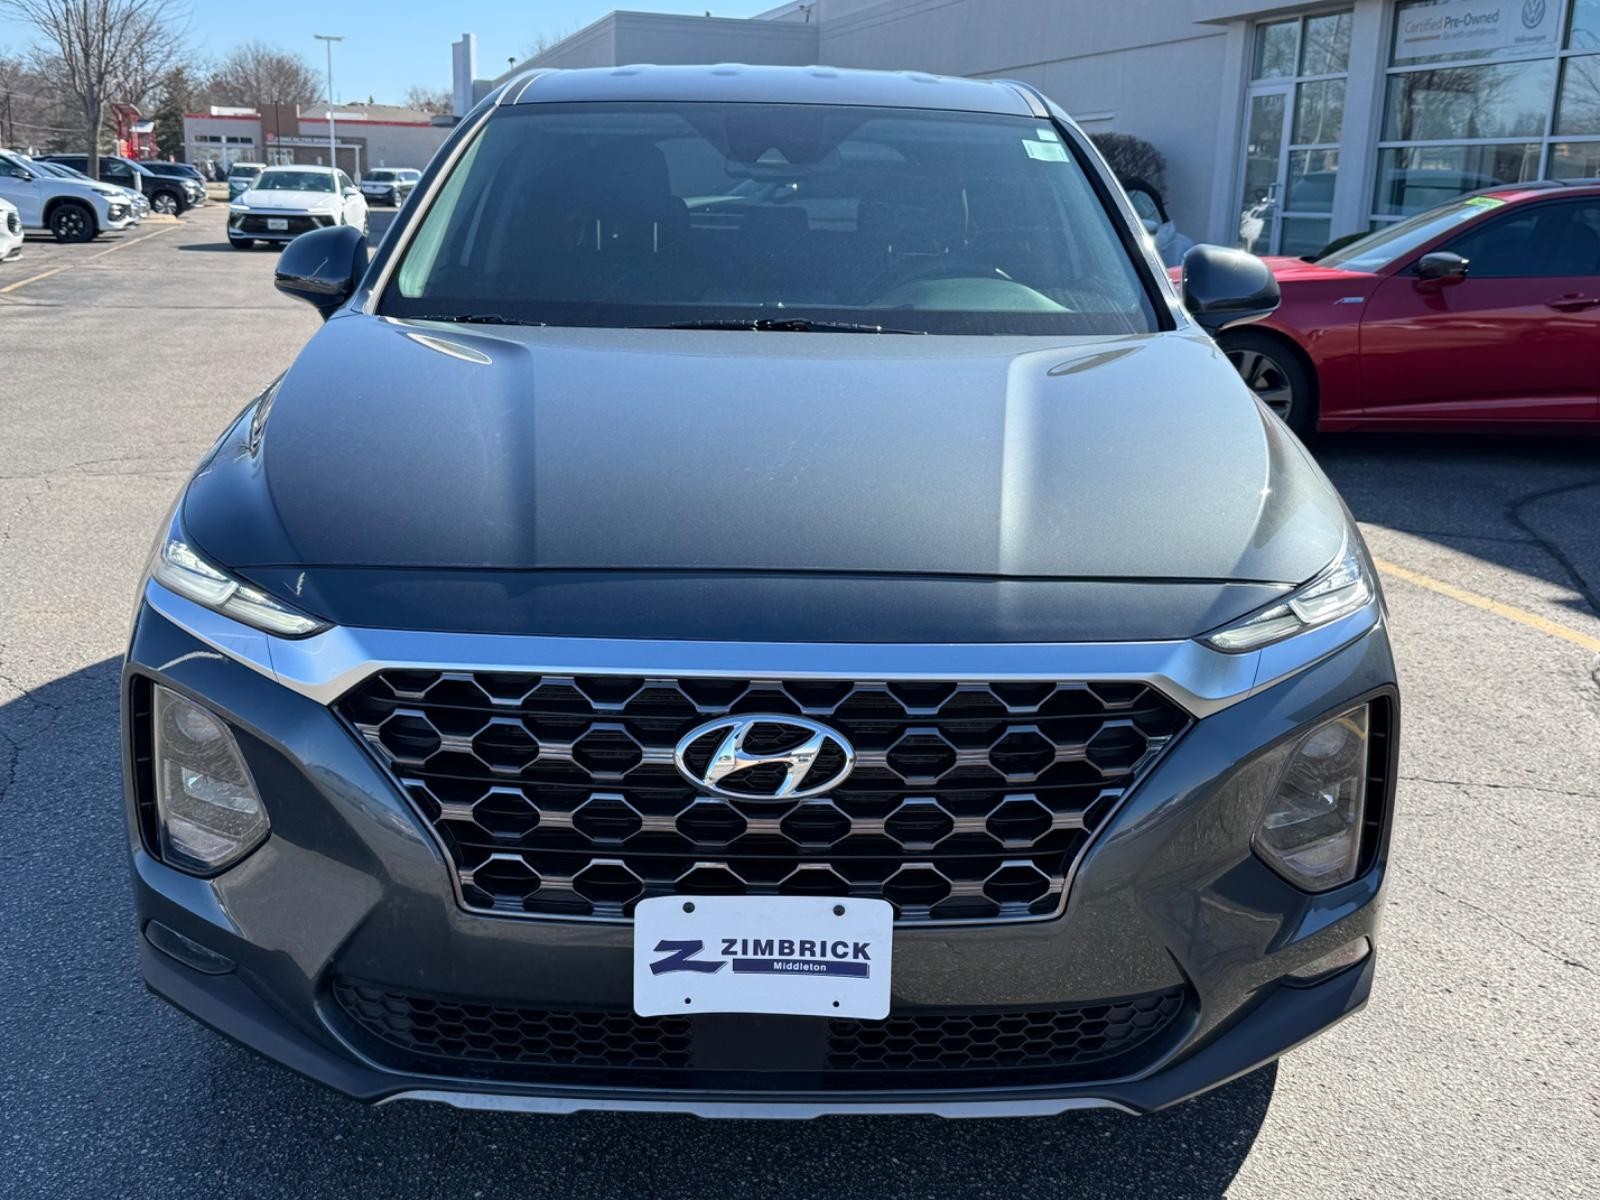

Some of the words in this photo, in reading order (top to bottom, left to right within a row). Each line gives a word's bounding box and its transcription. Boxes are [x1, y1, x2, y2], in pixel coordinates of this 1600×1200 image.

[1444, 9, 1499, 29] Pre-Owned
[721, 938, 871, 960] ZIMBRICK
[773, 961, 827, 972] Middleton
